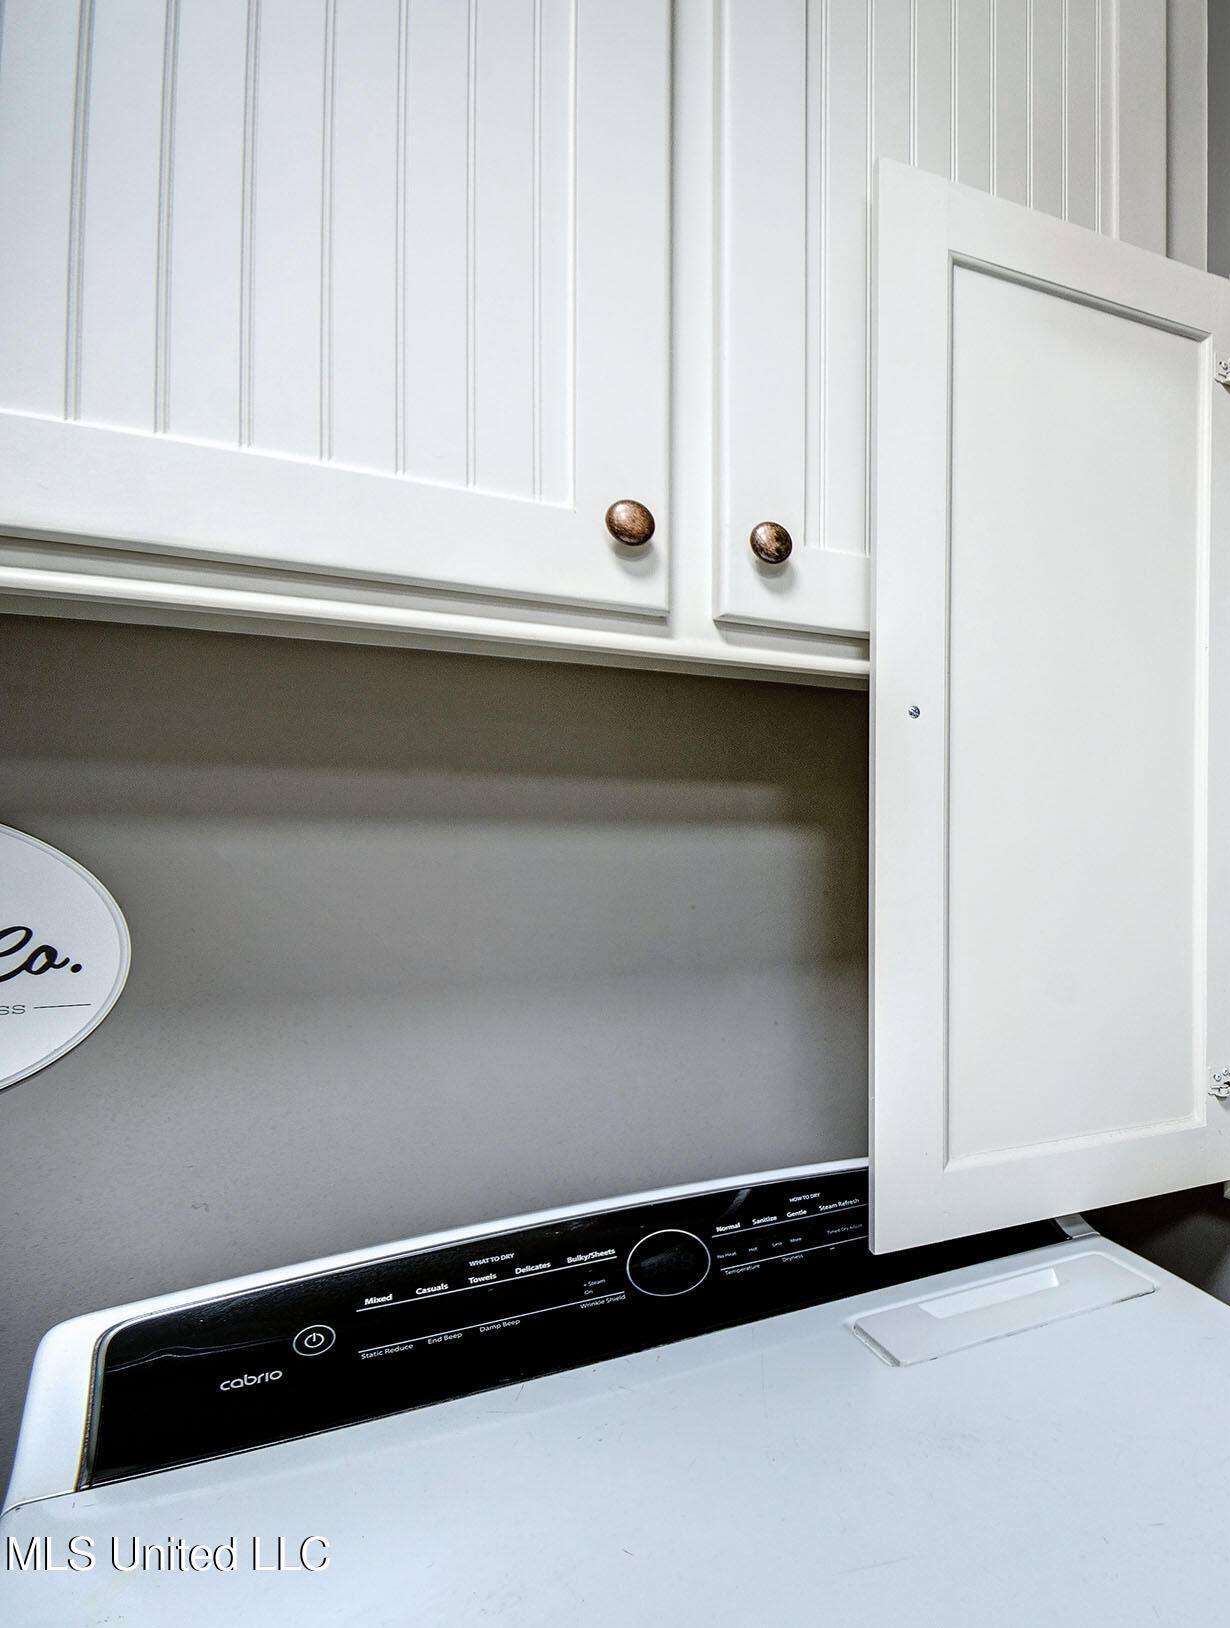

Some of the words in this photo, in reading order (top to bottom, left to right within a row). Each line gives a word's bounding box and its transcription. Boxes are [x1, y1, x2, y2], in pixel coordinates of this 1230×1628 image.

[716, 1222, 741, 1232] Normal
[752, 1216, 777, 1225] Sanitize
[786, 1209, 807, 1218] Gentle
[838, 1198, 859, 1207] Refresh
[364, 1294, 392, 1305] Mixed
[416, 1282, 448, 1295] Casuals
[468, 1273, 497, 1284] Towels
[515, 1262, 551, 1274] Delicates
[567, 1249, 616, 1264] Bulky/Sheets
[725, 1264, 760, 1275] Temperature
[580, 1300, 605, 1308] Wrinkle
[606, 1295, 626, 1303] Shield
[479, 1323, 501, 1333] Damp
[503, 1319, 520, 1328] Beep
[427, 1336, 442, 1344] End
[444, 1332, 463, 1342] Beep
[361, 1350, 383, 1360] Static
[385, 1344, 414, 1354] Reduce
[219, 1370, 283, 1391] cabrio
